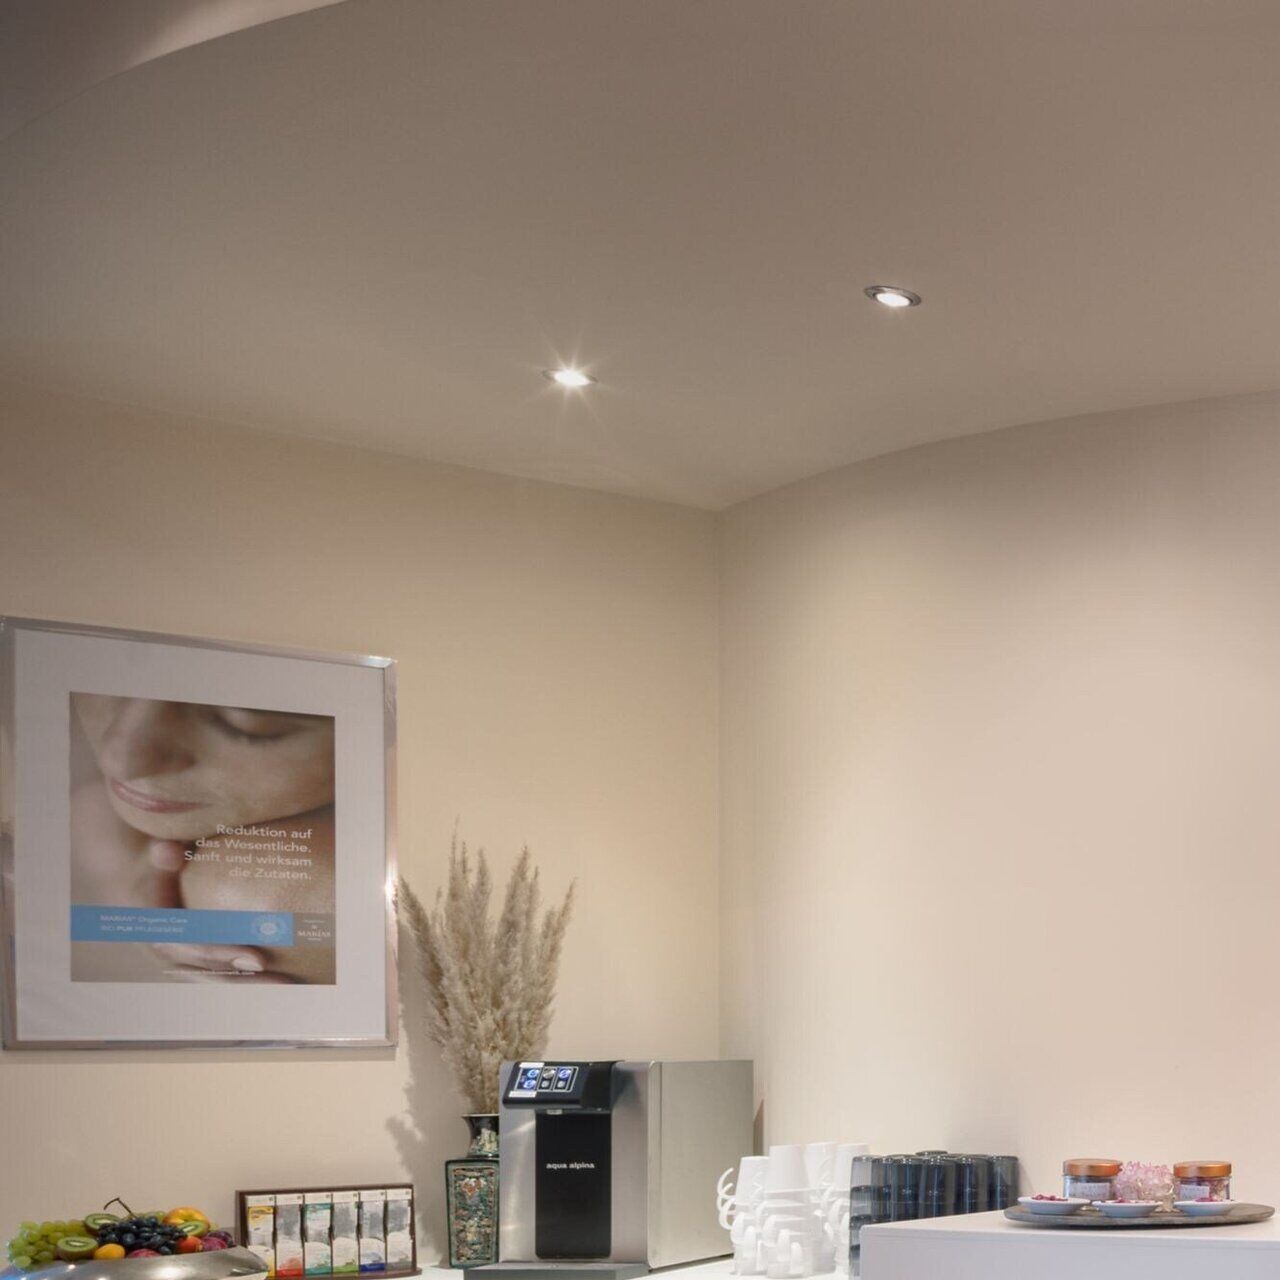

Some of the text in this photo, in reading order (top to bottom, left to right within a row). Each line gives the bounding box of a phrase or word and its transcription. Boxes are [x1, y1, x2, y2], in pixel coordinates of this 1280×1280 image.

[216, 824, 312, 839] Reduktion auf
[195, 837, 312, 853] das Wesentliche.
[184, 850, 312, 867] Sanft und wirksam
[228, 866, 251, 878] die
[569, 1161, 595, 1170] alpina
